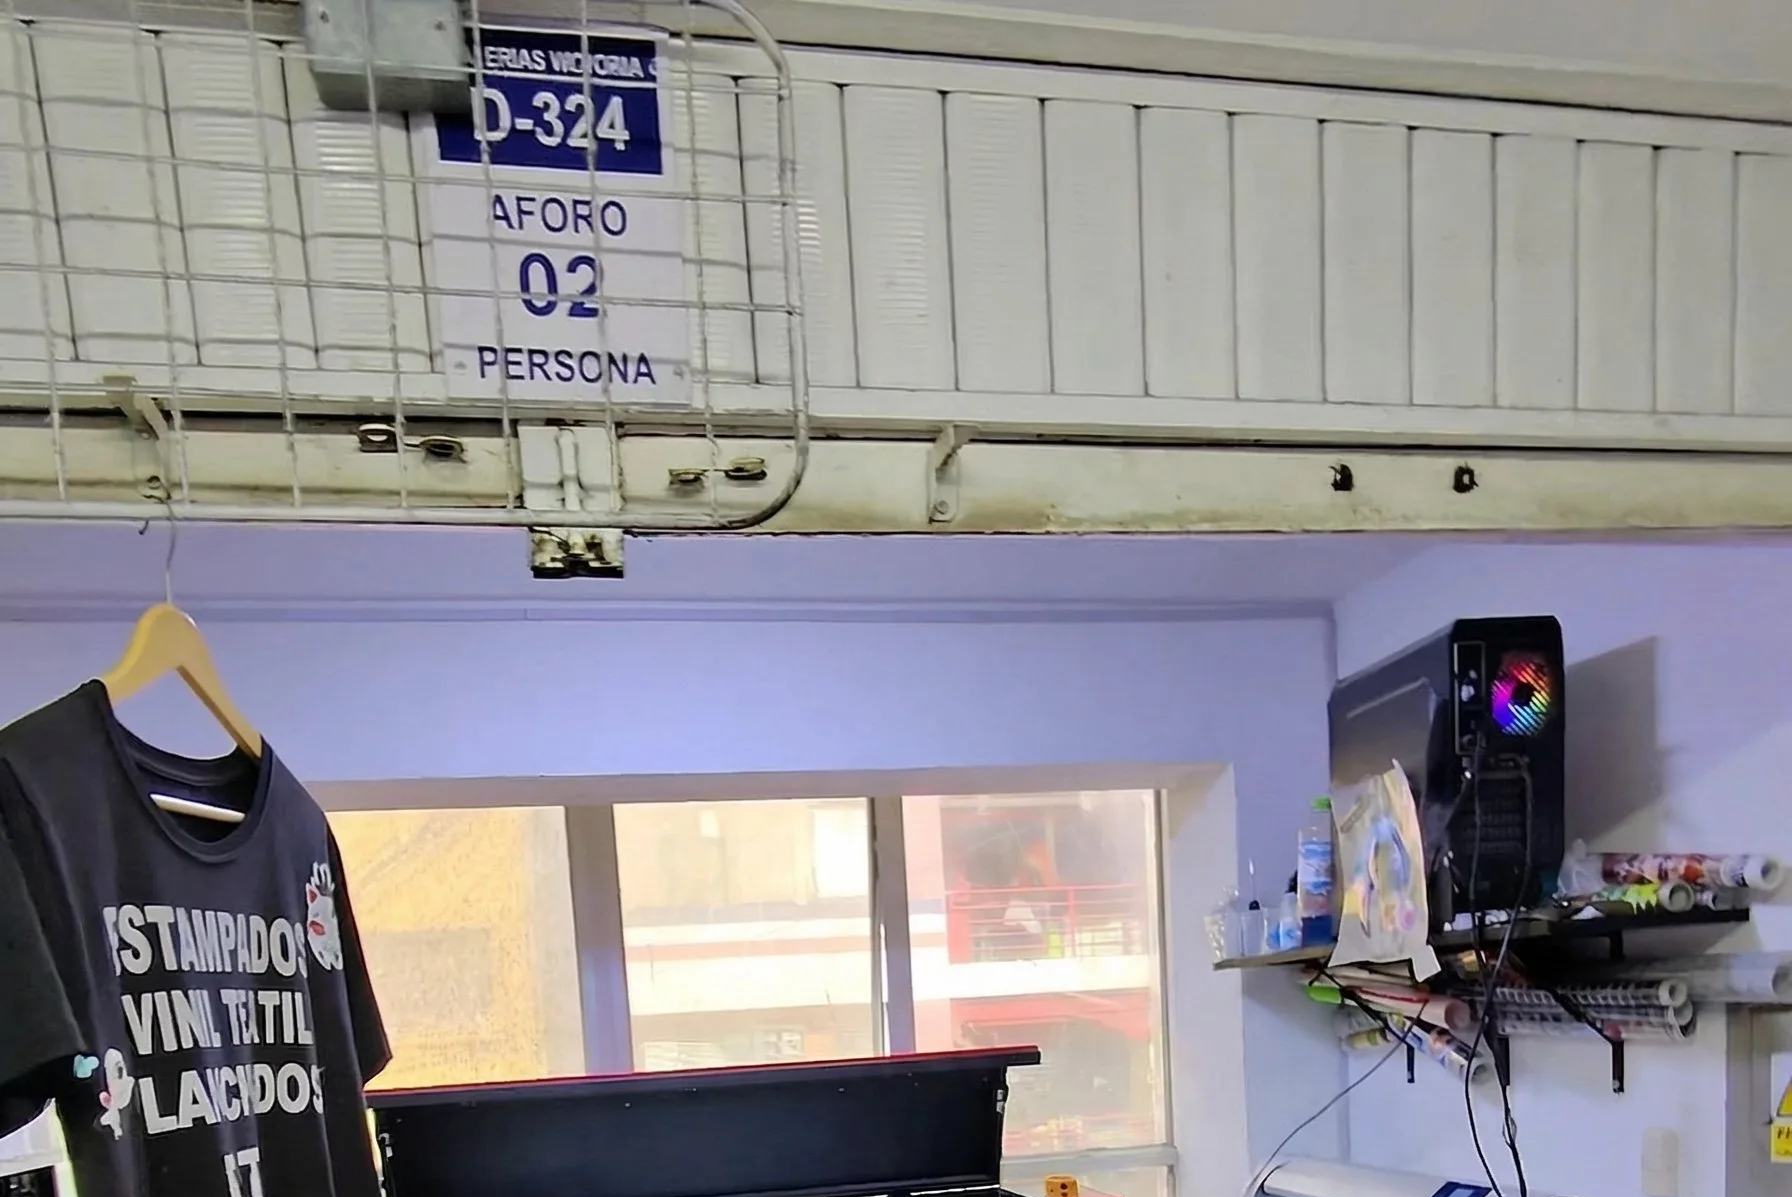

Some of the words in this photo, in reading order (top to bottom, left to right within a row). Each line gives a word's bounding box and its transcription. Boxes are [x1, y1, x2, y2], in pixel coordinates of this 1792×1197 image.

[484, 46, 546, 72] ERIAS
[470, 86, 630, 151] D-324
[492, 194, 628, 237] AFORO
[519, 252, 601, 319] 02
[477, 345, 657, 386] PERSONA
